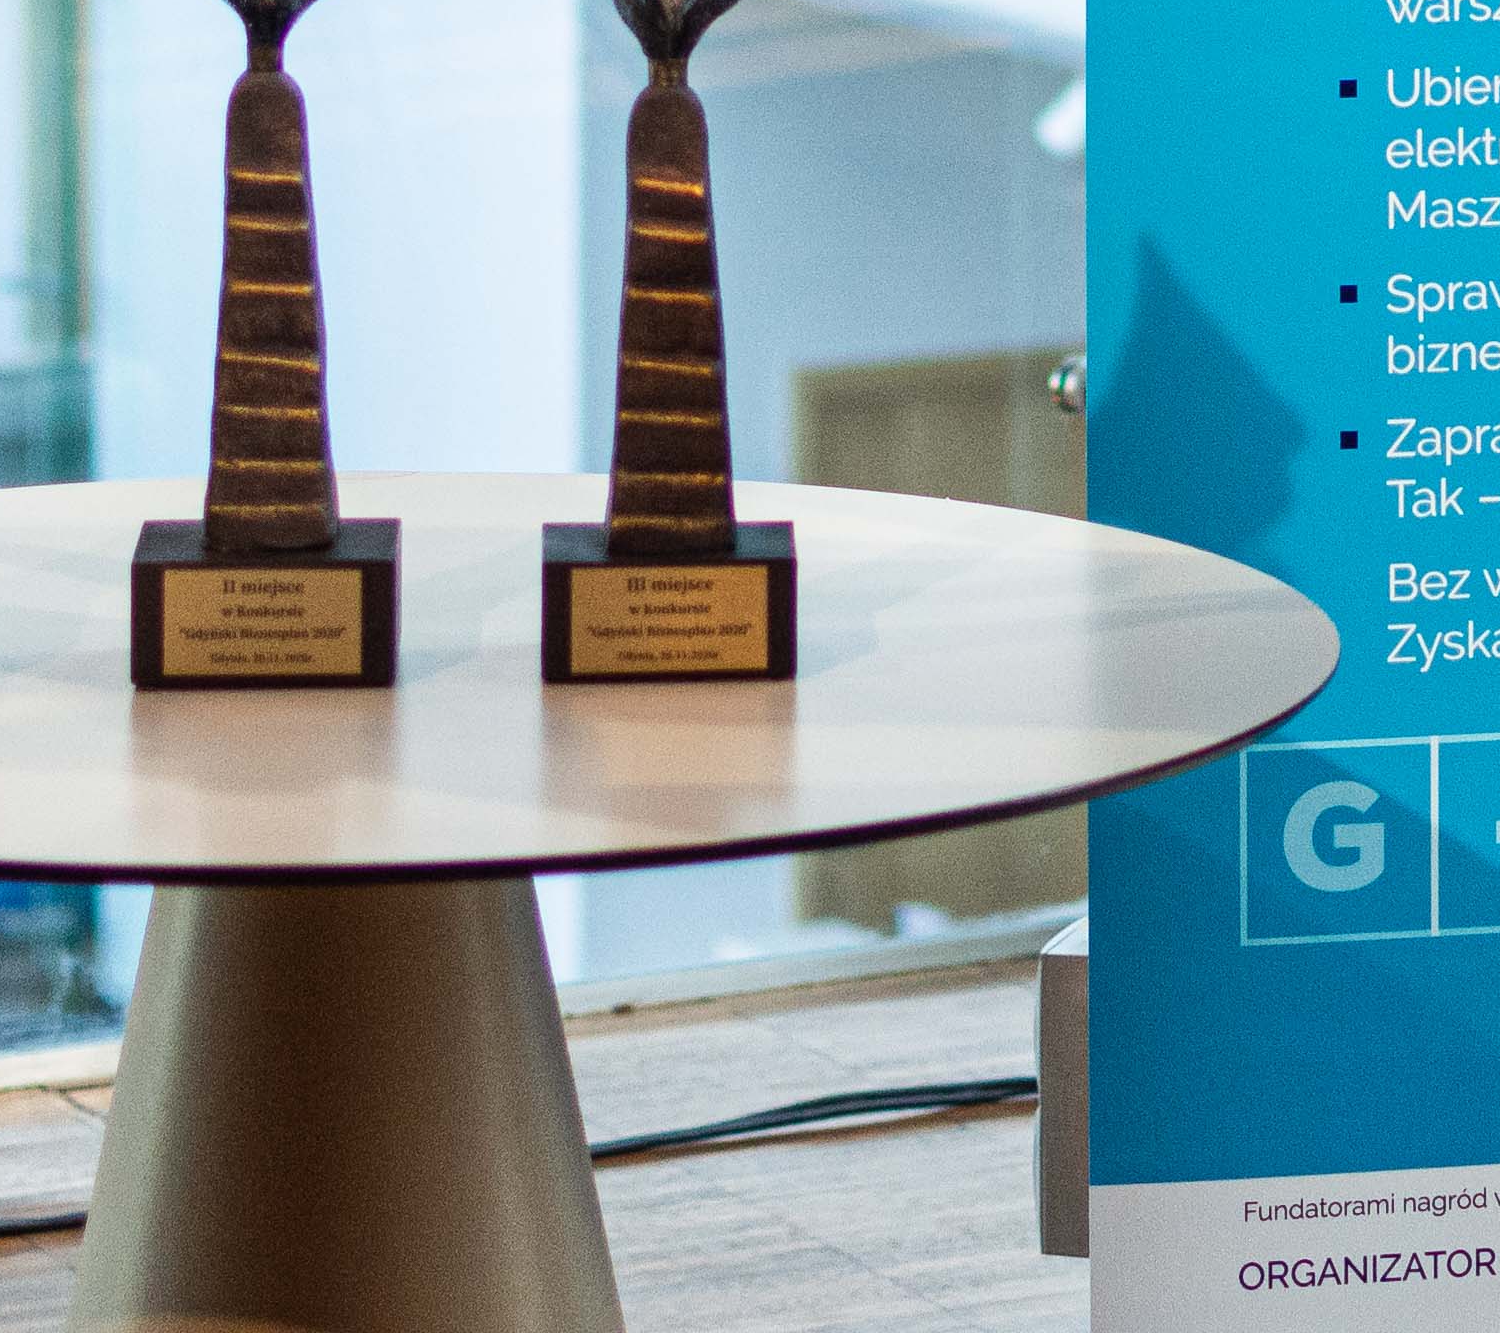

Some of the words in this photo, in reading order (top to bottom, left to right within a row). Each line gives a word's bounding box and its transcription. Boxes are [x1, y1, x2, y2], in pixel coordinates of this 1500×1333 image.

[1386, 478, 1464, 519] Tak
[1388, 562, 1471, 602] Bez
[1283, 780, 1385, 892] G
[1243, 1193, 1396, 1223] Fundatorami
[1402, 1186, 1488, 1217] nagród
[1238, 1246, 1497, 1292] ORGANIZATOR
